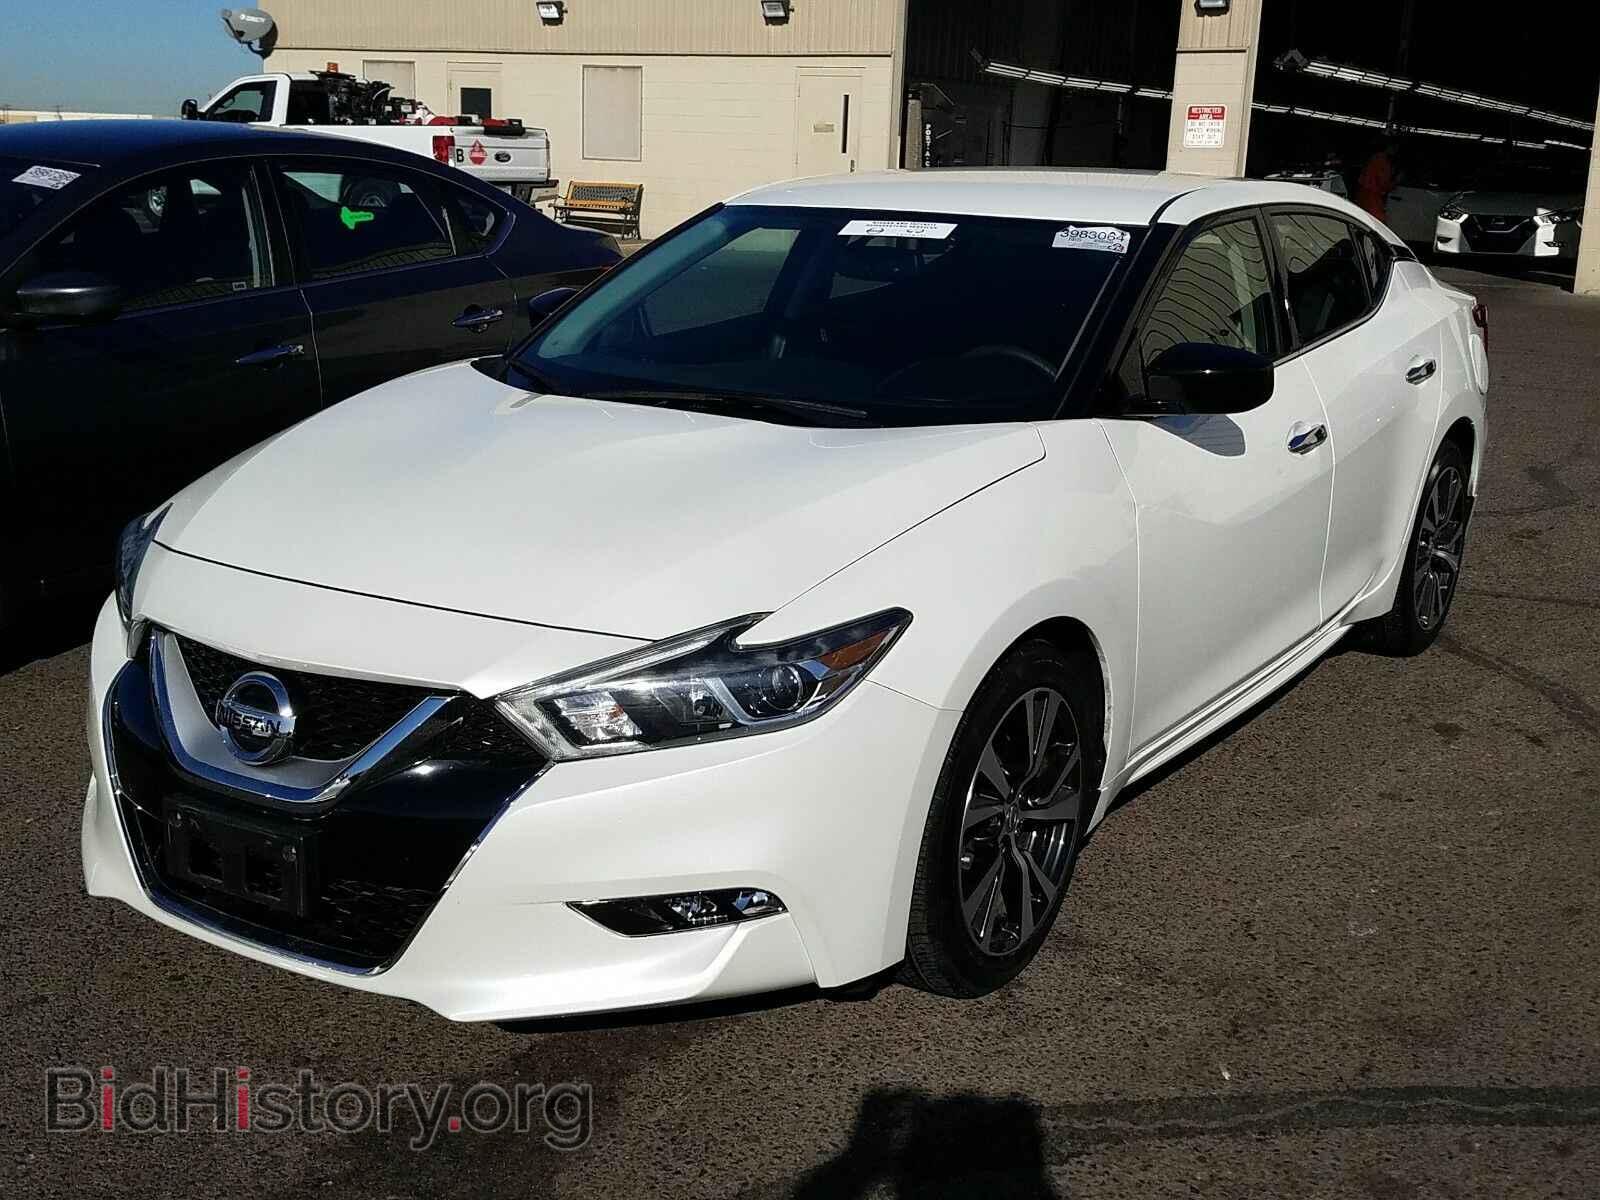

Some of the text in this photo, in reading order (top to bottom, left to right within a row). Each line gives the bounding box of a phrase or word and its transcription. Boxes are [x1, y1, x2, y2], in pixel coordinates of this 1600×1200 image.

[456, 148, 464, 163] B
[1060, 228, 1126, 242] 3983064
[217, 706, 281, 733] NISSAN
